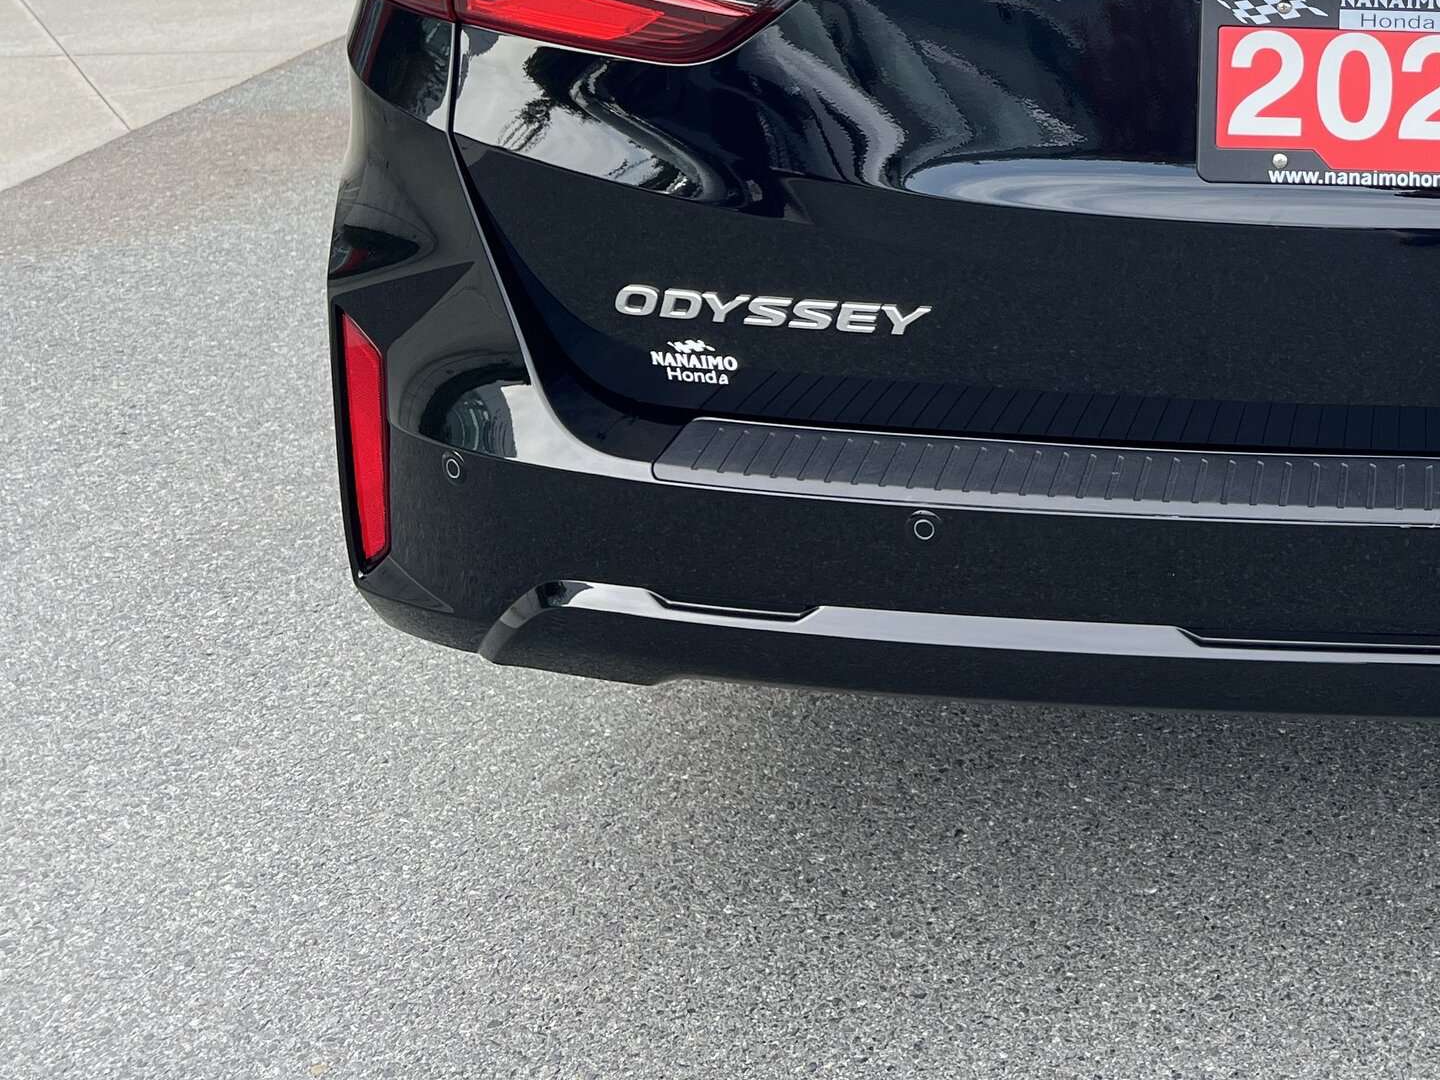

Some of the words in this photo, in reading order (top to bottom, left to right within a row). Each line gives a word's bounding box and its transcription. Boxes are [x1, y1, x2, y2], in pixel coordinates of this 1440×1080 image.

[1359, 13, 1435, 30] Honda
[614, 283, 933, 335] ODYSSEY
[650, 350, 738, 371] NANAIMO
[666, 367, 730, 385] Honda
